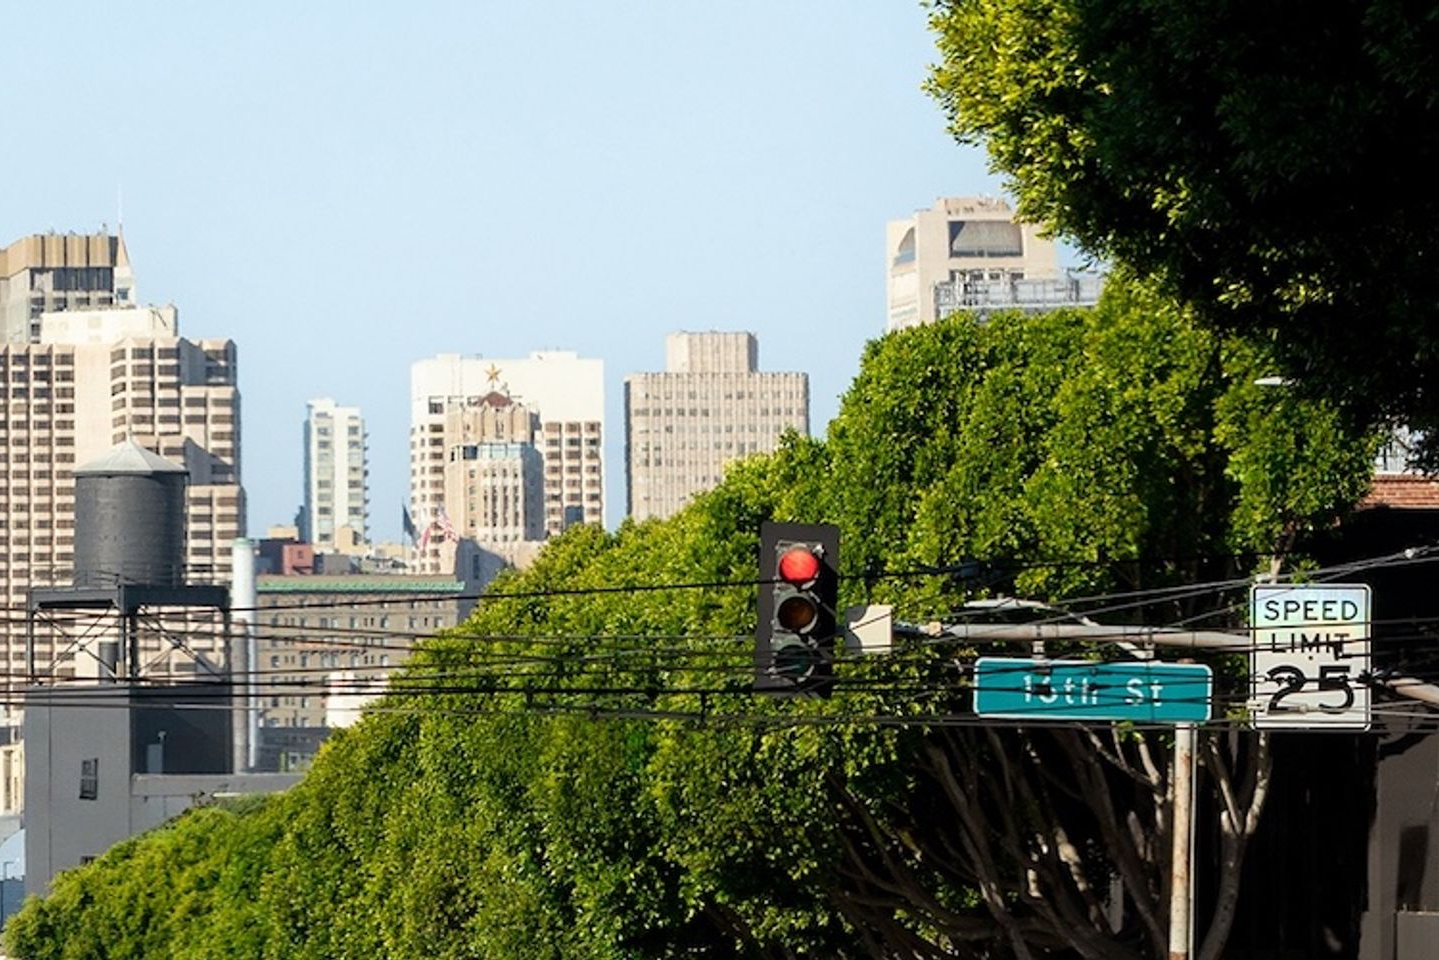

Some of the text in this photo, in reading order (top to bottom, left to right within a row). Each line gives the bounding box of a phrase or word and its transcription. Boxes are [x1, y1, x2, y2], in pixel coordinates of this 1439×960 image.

[1264, 600, 1358, 621] SPEED
[1271, 633, 1350, 653] LIMIT
[1125, 678, 1163, 707] St
[1266, 665, 1355, 714] 25
